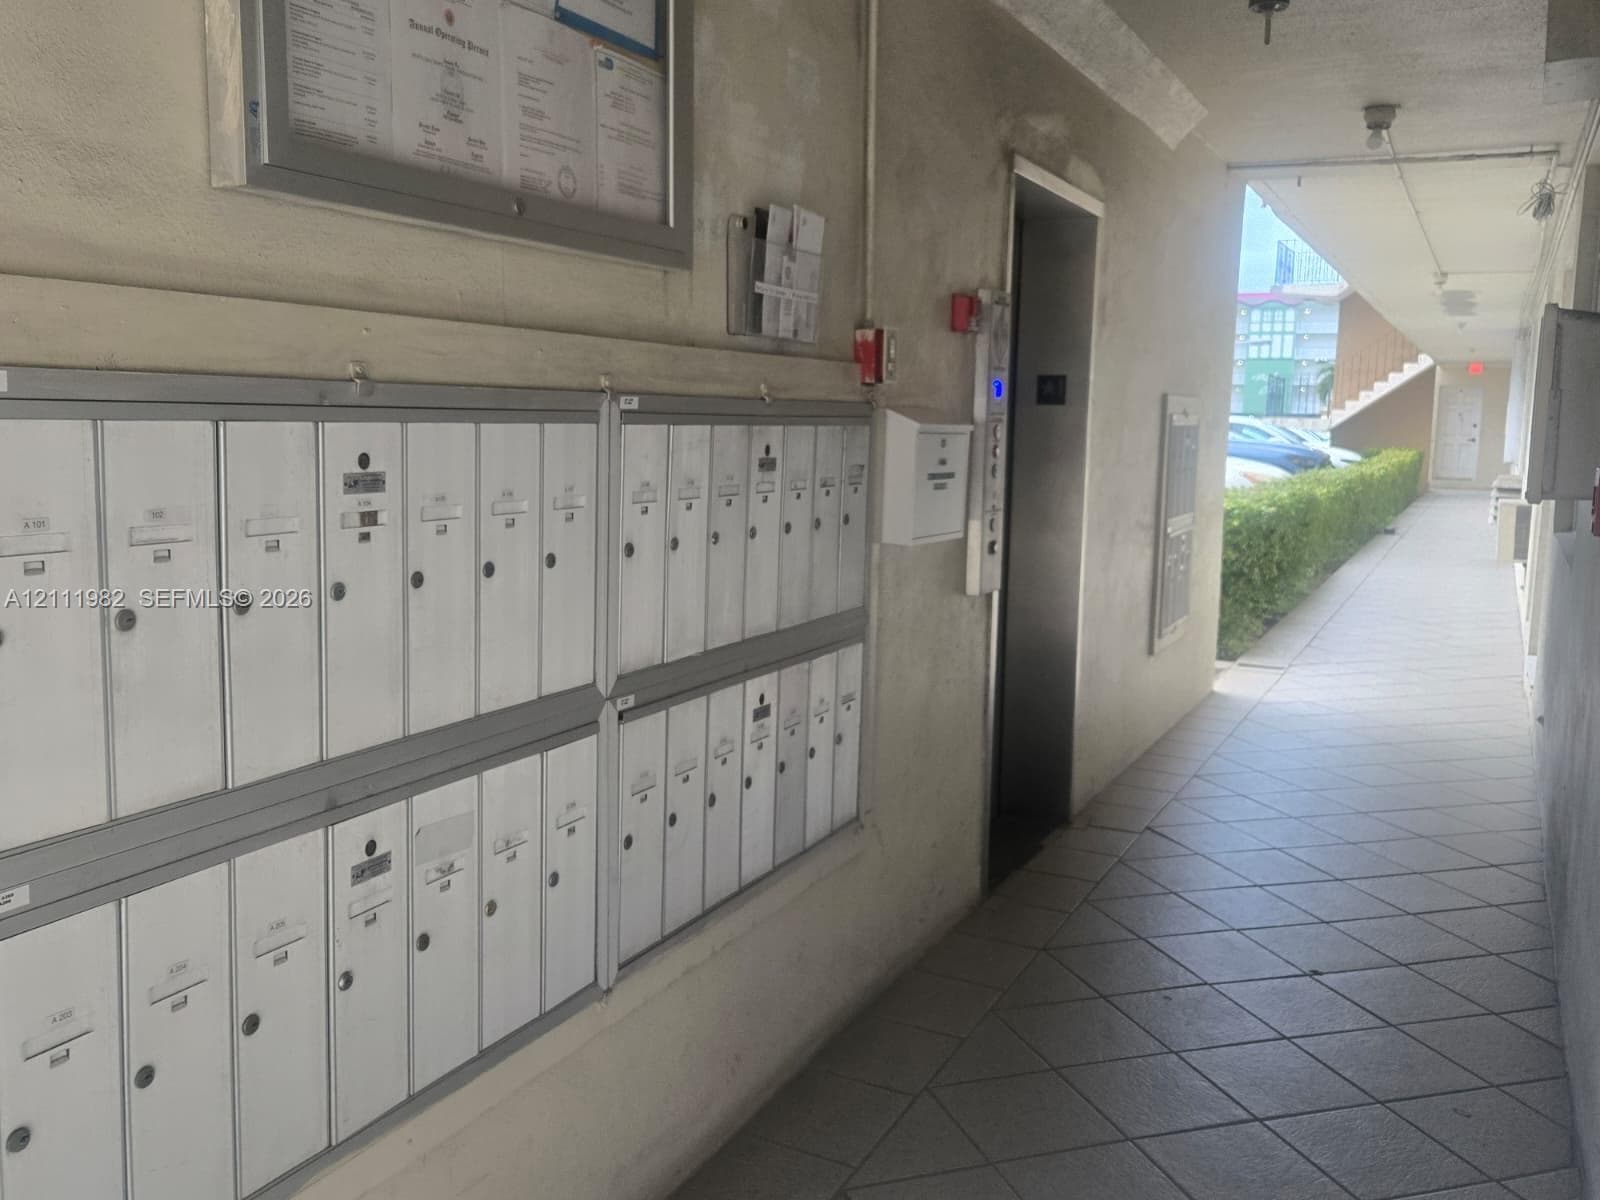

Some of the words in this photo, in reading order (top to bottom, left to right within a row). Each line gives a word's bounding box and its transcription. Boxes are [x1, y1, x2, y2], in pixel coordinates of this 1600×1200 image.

[408, 18, 434, 35] Annual
[435, 27, 466, 49] Operating
[467, 39, 489, 57] Permit
[151, 511, 164, 519] 102
[23, 521, 30, 529] A
[32, 520, 46, 529] 101
